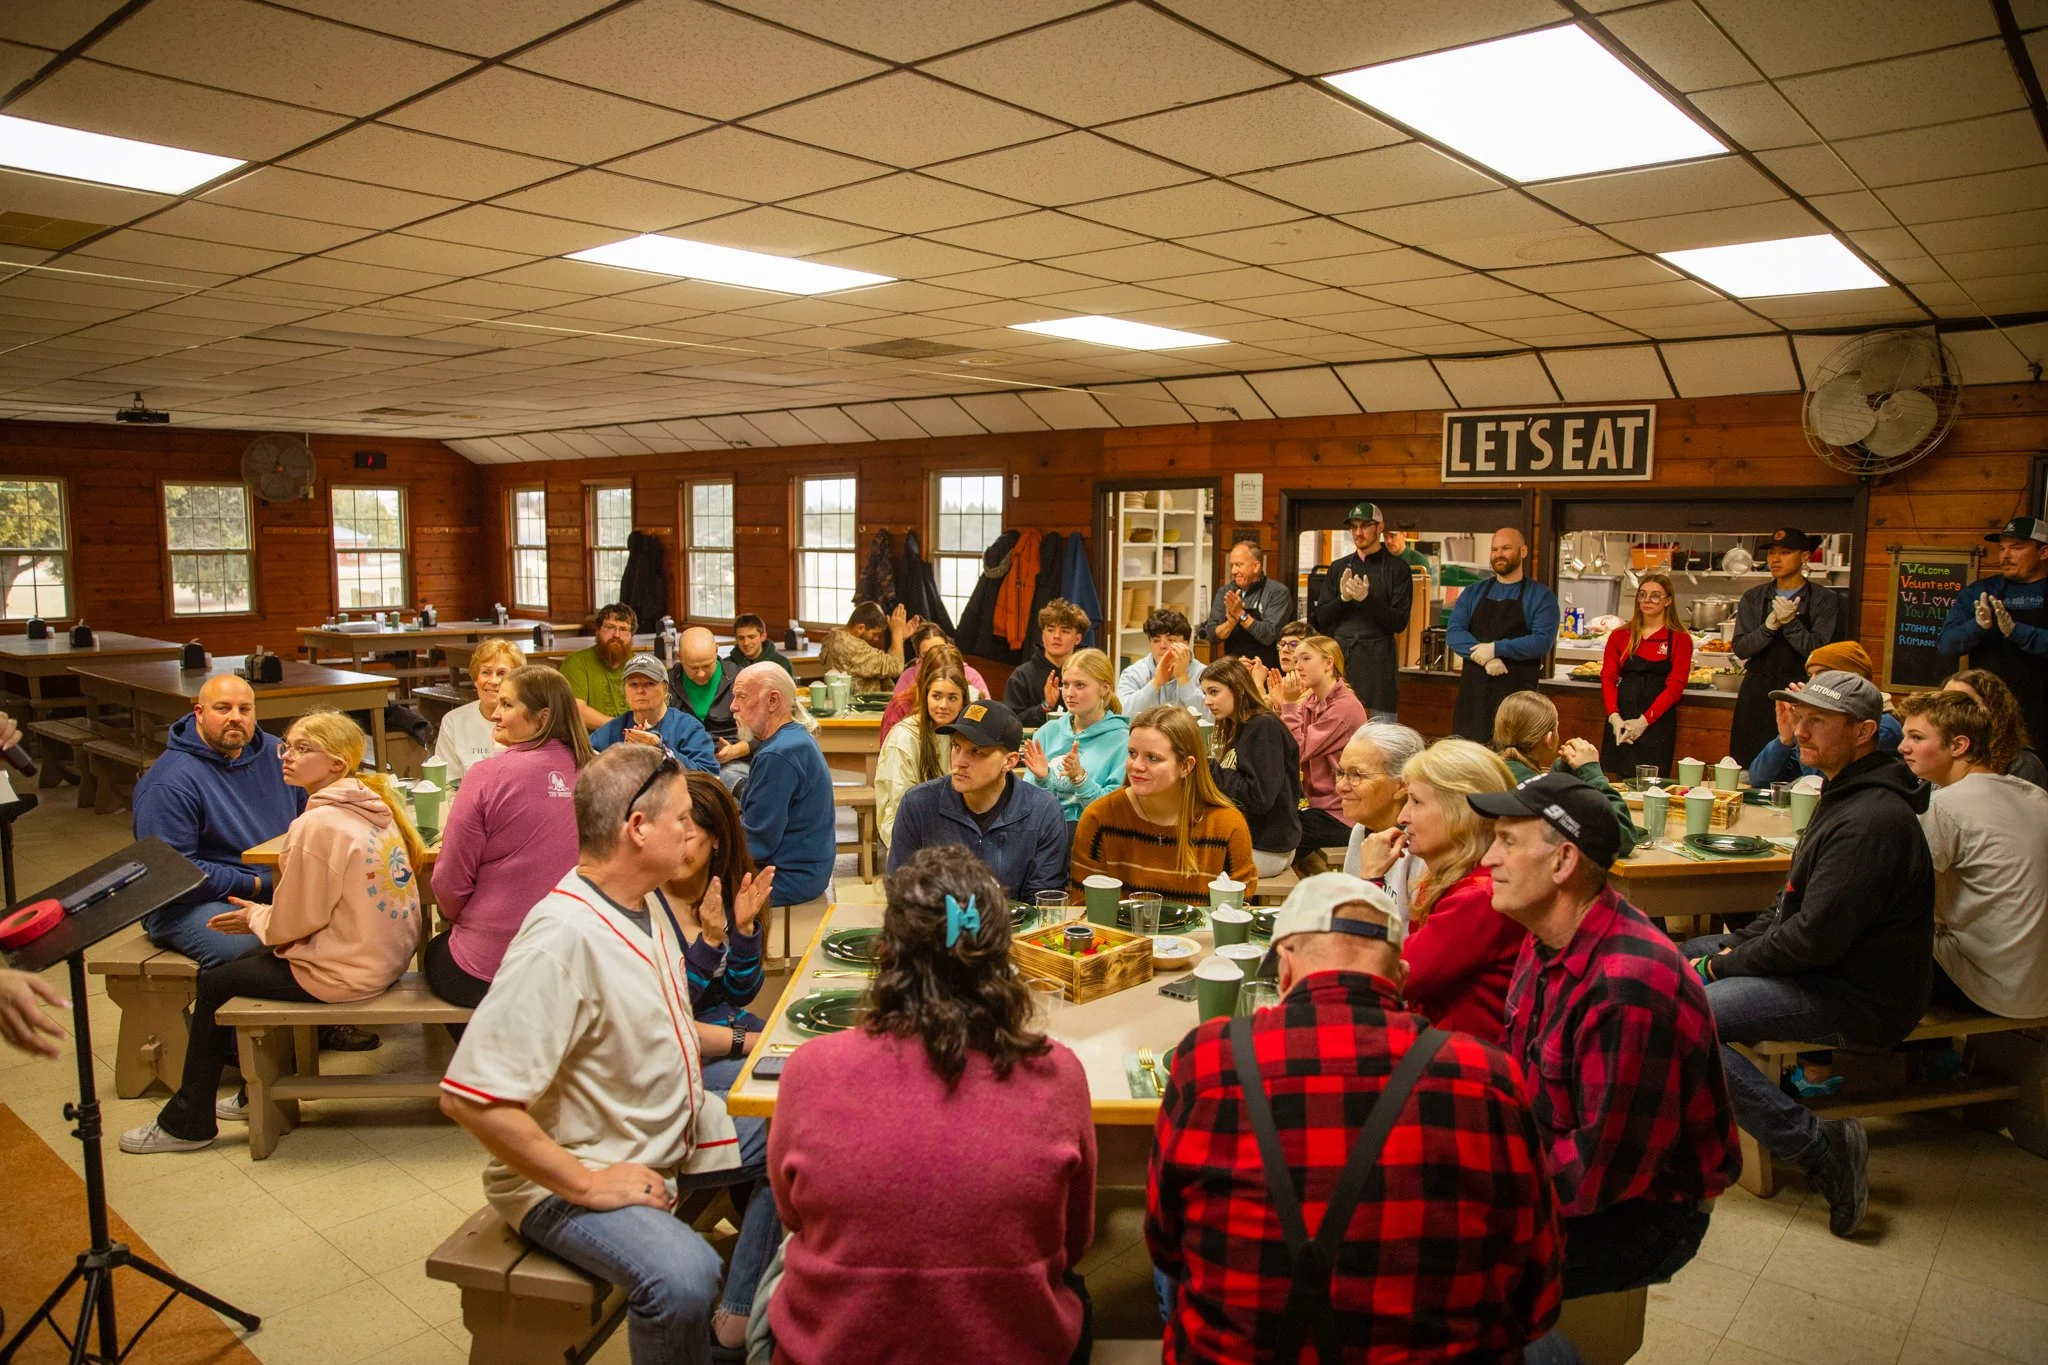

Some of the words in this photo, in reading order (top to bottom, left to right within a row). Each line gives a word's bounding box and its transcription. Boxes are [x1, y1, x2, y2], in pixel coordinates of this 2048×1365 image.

[1451, 417, 1554, 471] LET'S
[1562, 416, 1644, 470] EAT
[1901, 575, 1961, 591] Volunteers
[1901, 591, 1918, 604] We
[1905, 604, 1924, 618] You
[1899, 634, 1936, 647] ROMANS
[1810, 683, 1842, 700] ASTOUND
